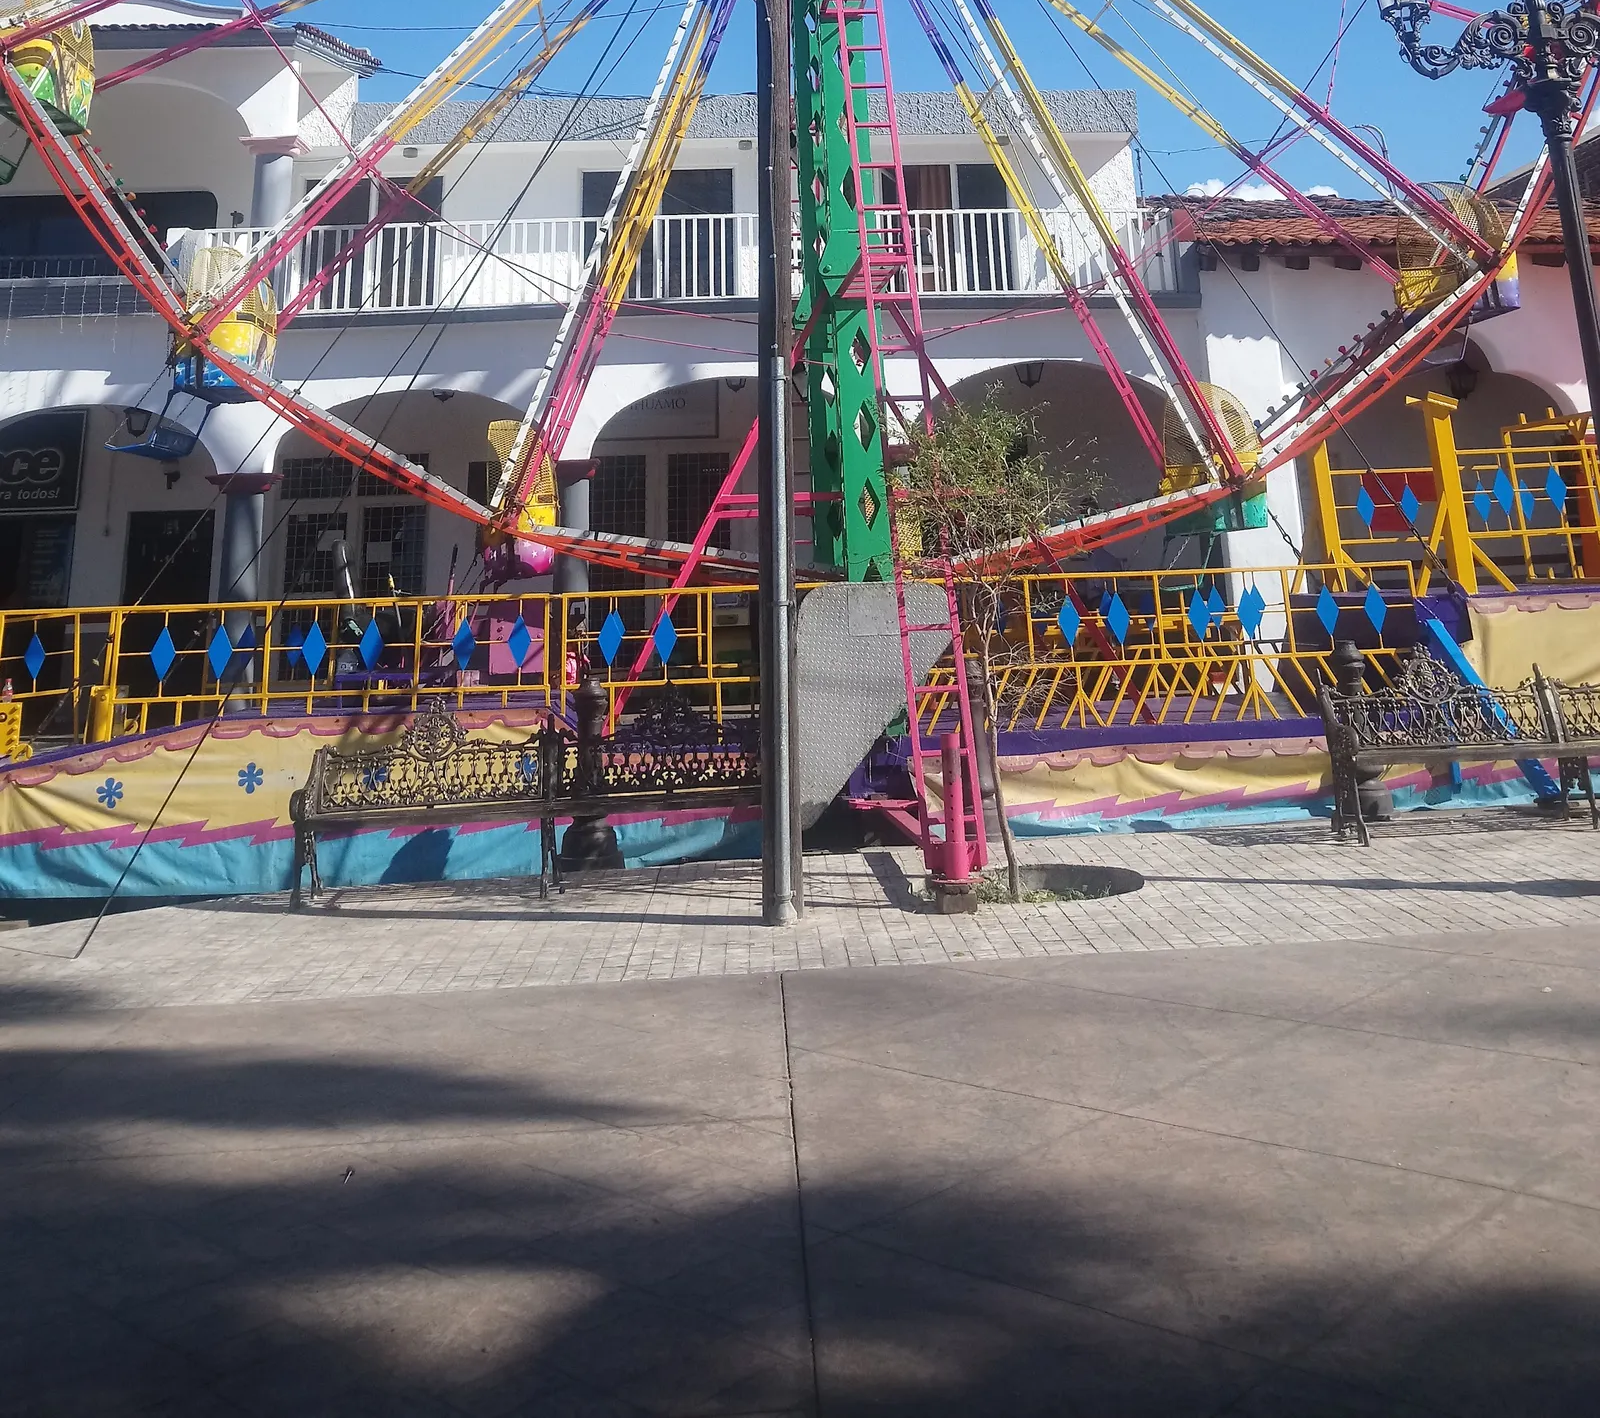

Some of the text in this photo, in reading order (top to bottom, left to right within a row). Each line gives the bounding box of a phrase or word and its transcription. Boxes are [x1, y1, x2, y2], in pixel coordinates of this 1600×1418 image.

[0, 448, 64, 484] ce
[0, 487, 60, 500] ra todos!
